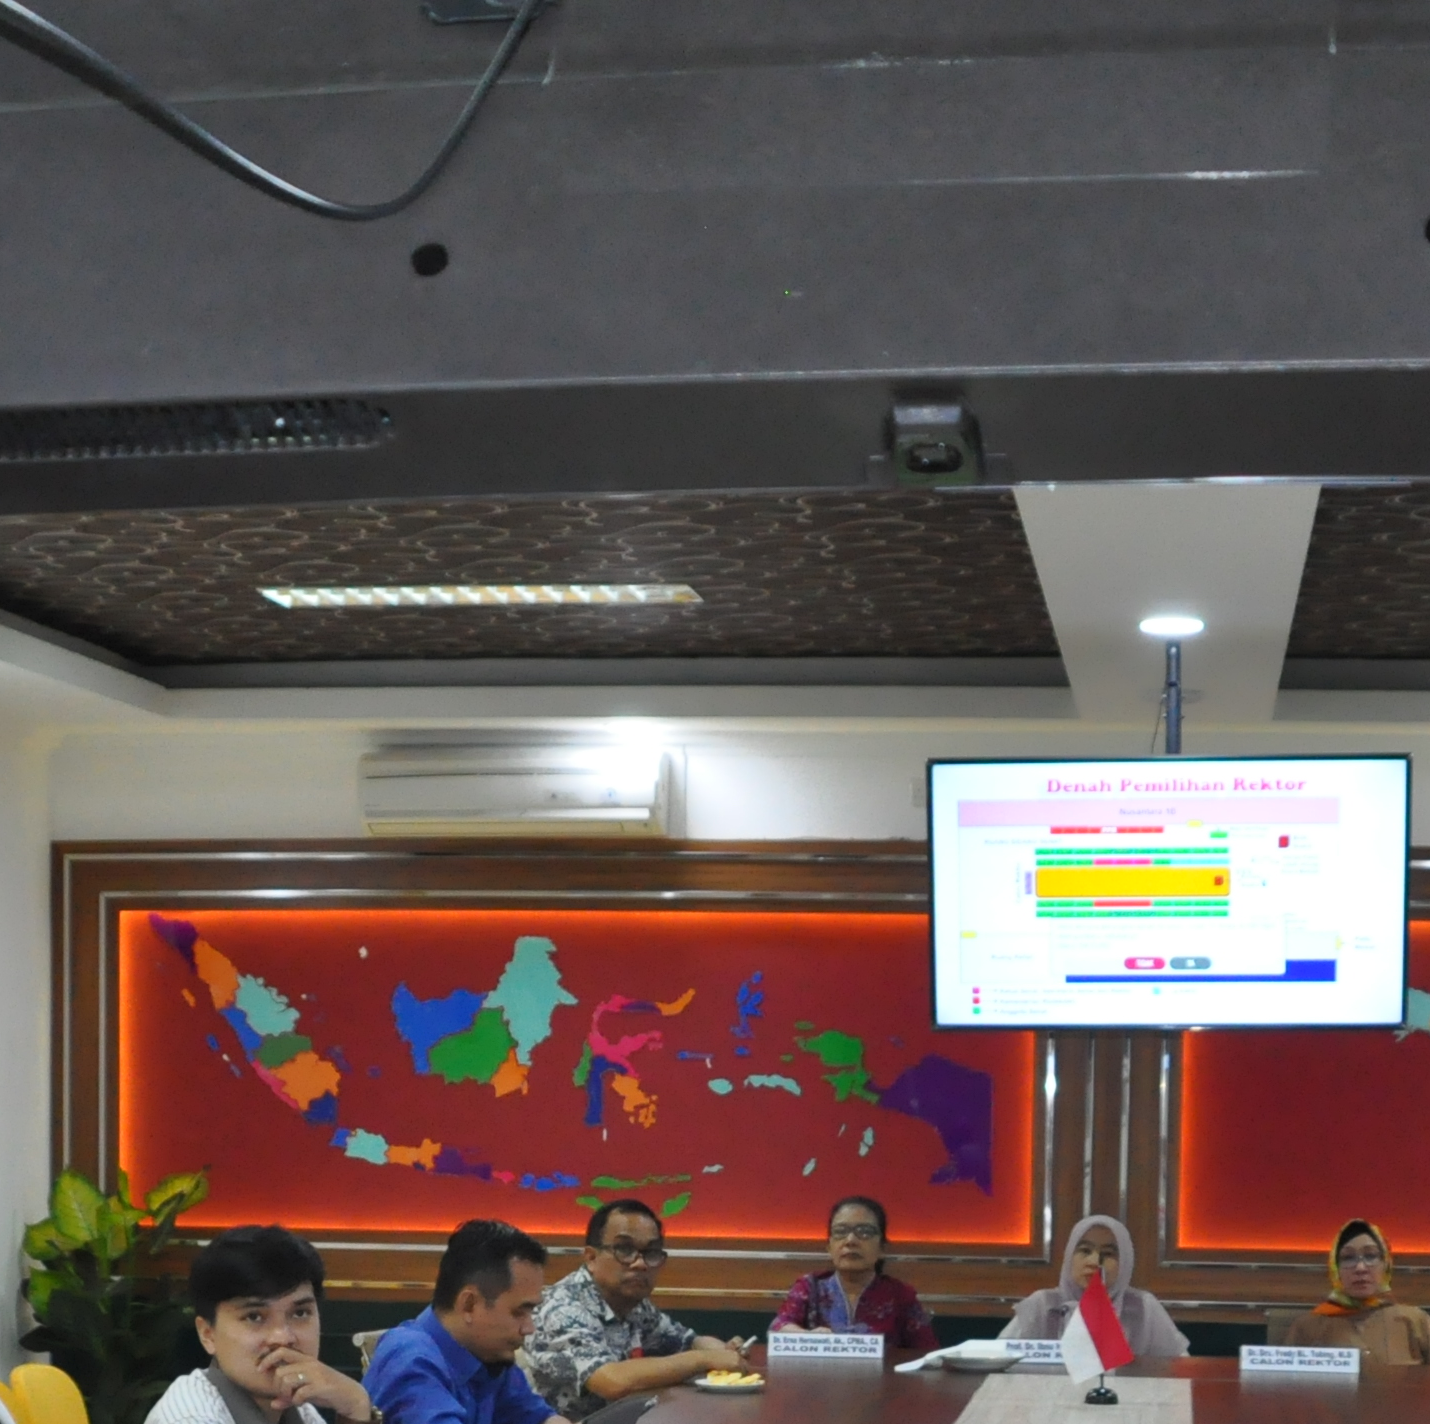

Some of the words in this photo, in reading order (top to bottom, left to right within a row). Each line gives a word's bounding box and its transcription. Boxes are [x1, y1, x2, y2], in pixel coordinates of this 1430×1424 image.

[1046, 777, 1113, 793] Denah
[1119, 777, 1226, 793] Pemilihan
[1232, 776, 1308, 792] Rektor
[773, 1345, 819, 1353] CALON
[822, 1346, 877, 1354] REKTOR
[1250, 1357, 1294, 1366] CALON
[1298, 1359, 1351, 1367] REKTOR
